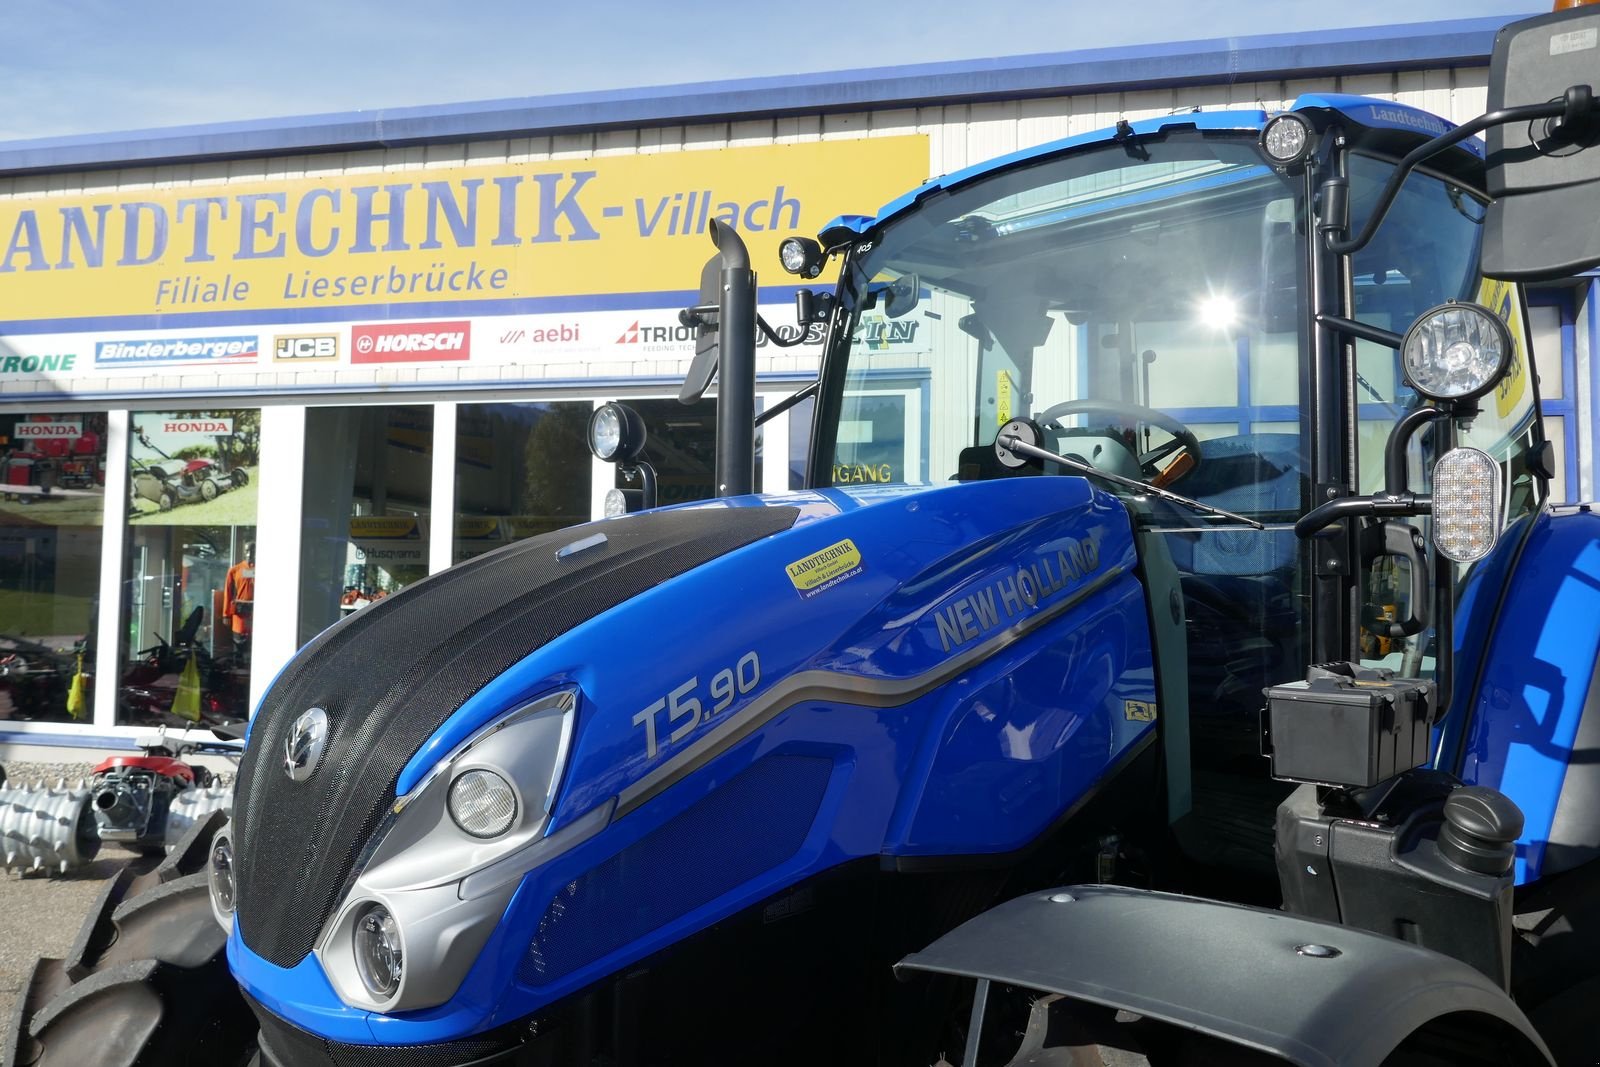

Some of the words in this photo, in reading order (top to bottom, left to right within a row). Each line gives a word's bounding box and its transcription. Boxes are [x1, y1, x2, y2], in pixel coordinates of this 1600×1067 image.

[155, 274, 249, 305] Filiale
[283, 262, 508, 300] Lieserbrücke
[375, 332, 464, 352] HORSCH
[533, 323, 579, 343] aebi
[99, 339, 257, 359] Binderberger
[277, 337, 336, 358] JCB
[643, 344, 675, 352] FEEDING
[0, 354, 76, 373] RONE
[18, 424, 78, 436] HONDA
[164, 421, 228, 433] HONDA
[366, 547, 421, 560] Husqvarna
[789, 542, 853, 577] LANDTECHNIK
[805, 575, 822, 587] Villach
[826, 560, 855, 578] Lieserbrücke
[805, 566, 863, 598] www.landtechnik.co.at
[933, 585, 1000, 652] NEW
[996, 537, 1101, 617] HOLLAND
[632, 650, 761, 760] T5.90
